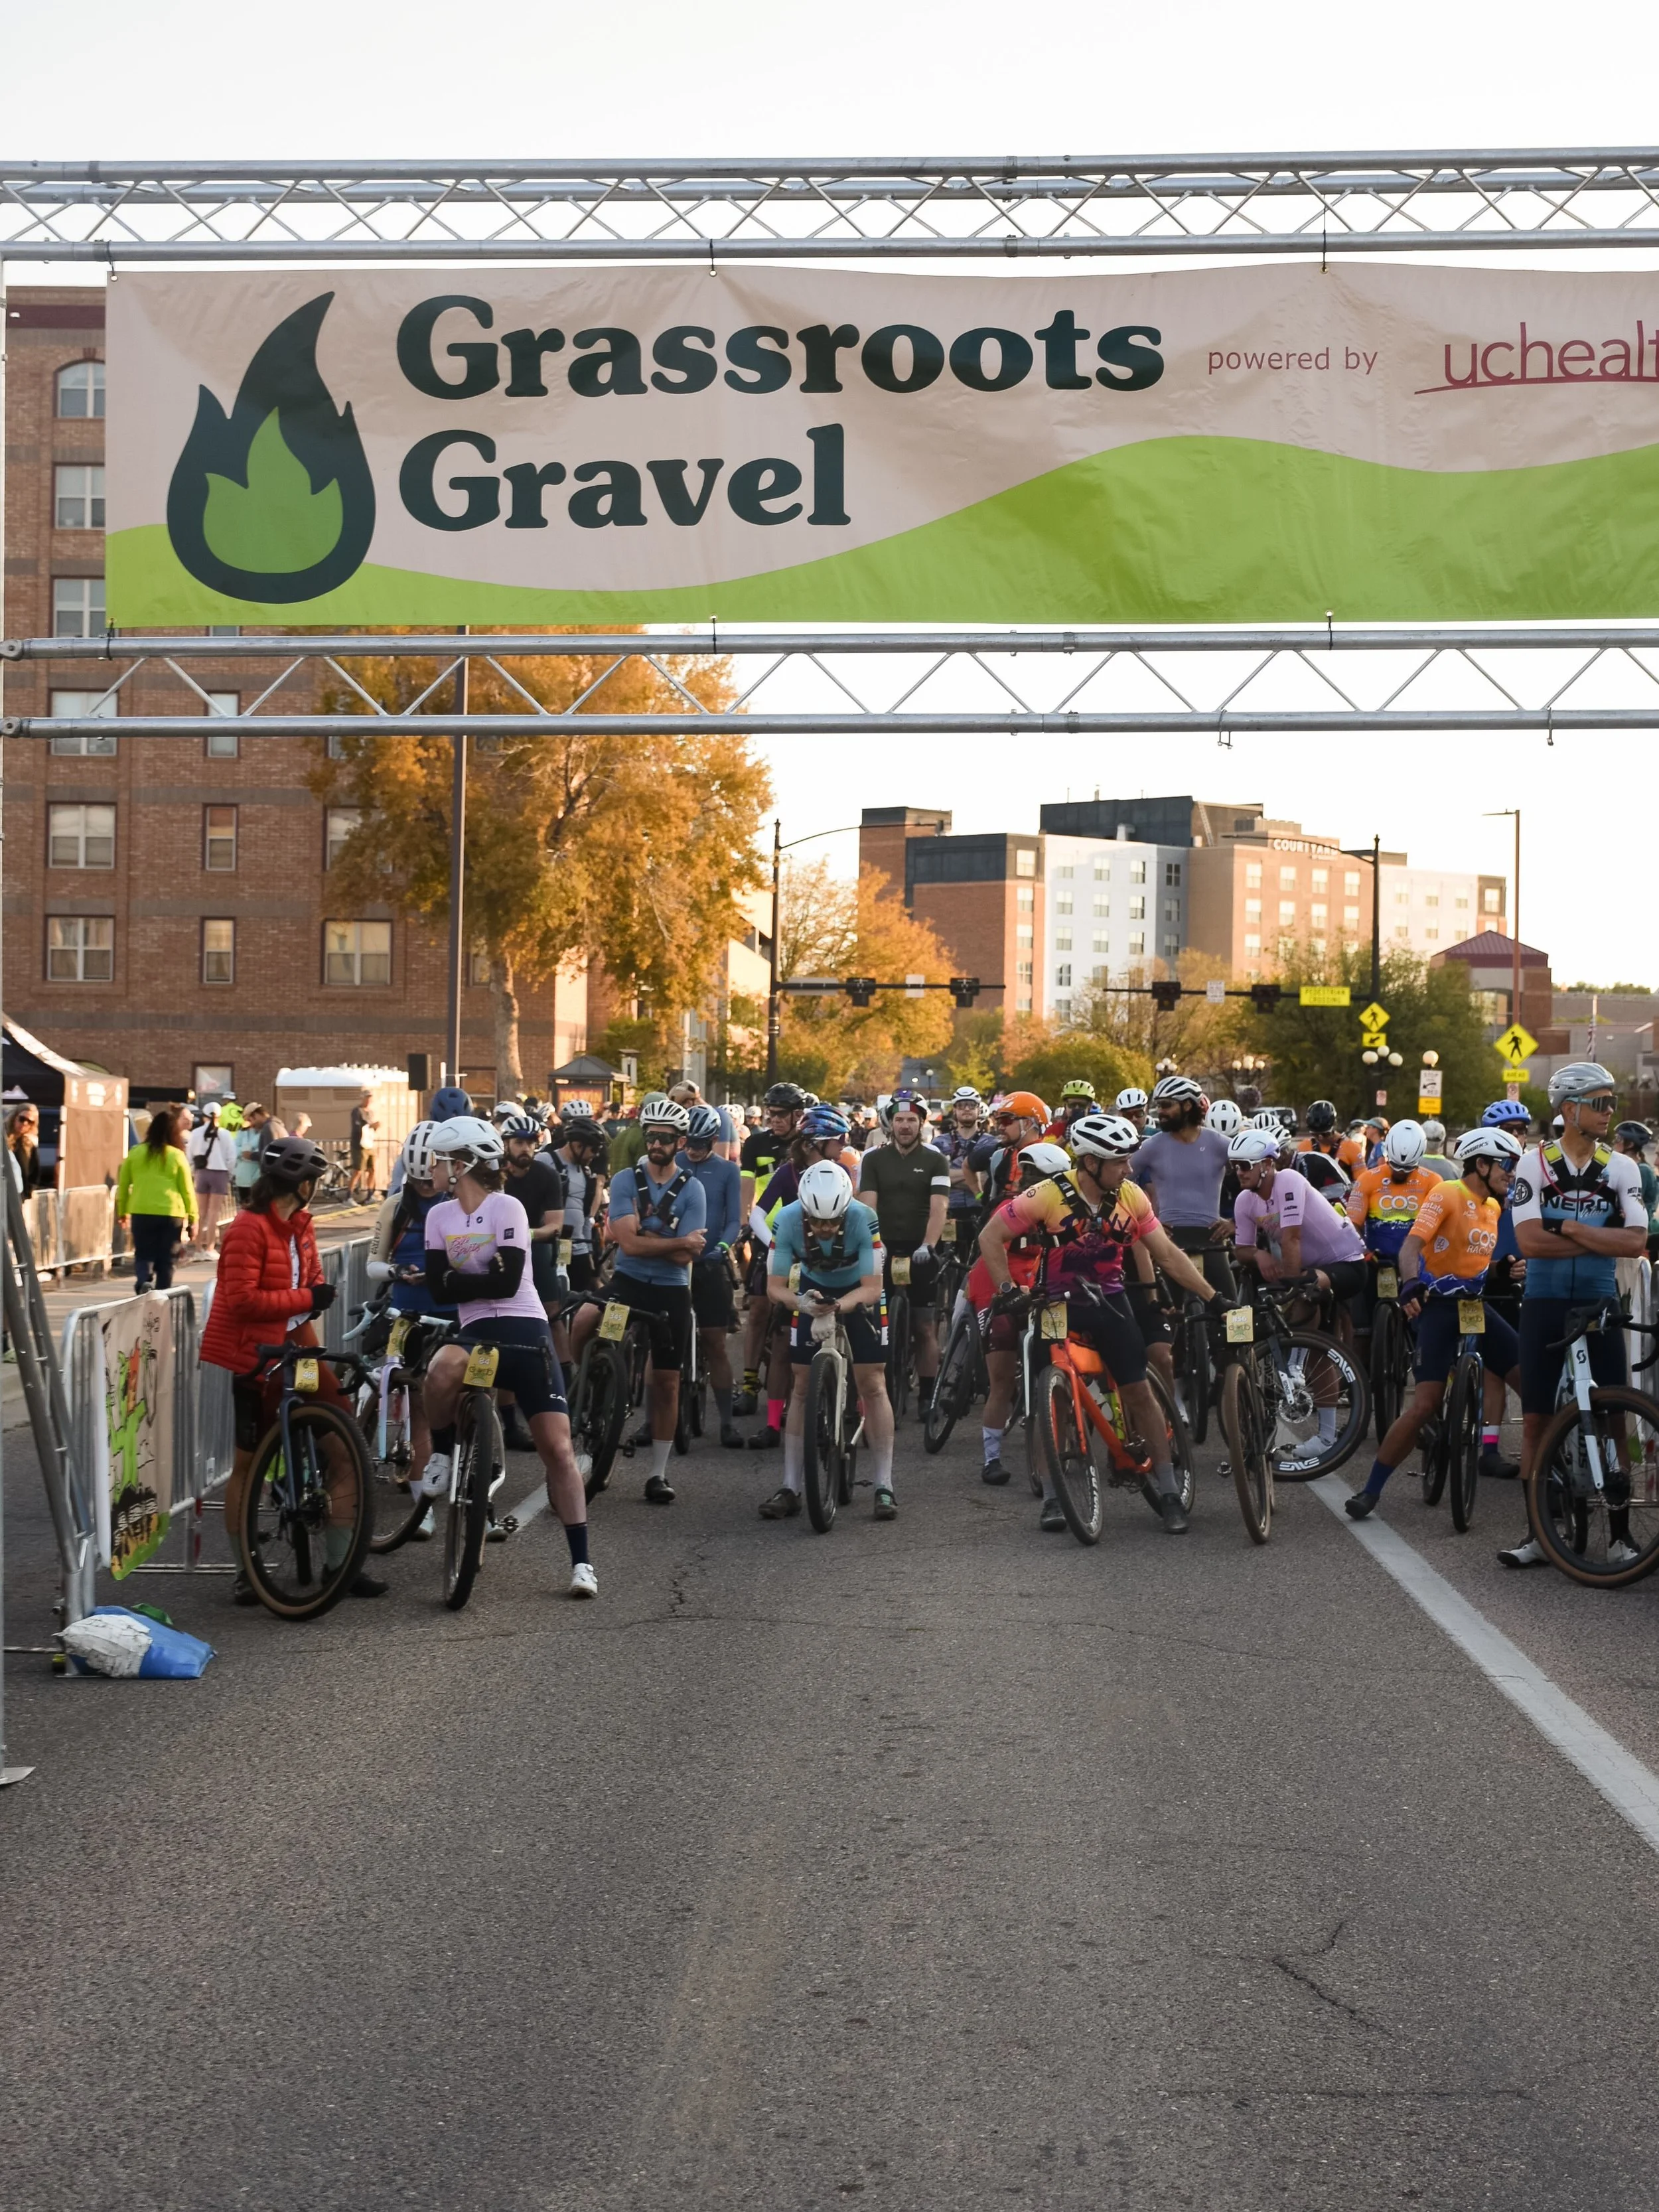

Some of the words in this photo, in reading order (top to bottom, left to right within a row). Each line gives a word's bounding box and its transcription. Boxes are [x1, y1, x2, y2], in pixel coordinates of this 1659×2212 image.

[397, 295, 1164, 400] Grassroots
[1208, 346, 1330, 375] powered
[1345, 346, 1378, 375] by
[399, 423, 851, 532] Gravel
[1273, 838, 1338, 855] COURTYARD
[1459, 1142, 1488, 1157] S-WORKS
[1378, 1195, 1419, 1211] COS
[1544, 1197, 1609, 1213] NERO
[1468, 1228, 1497, 1248] COS
